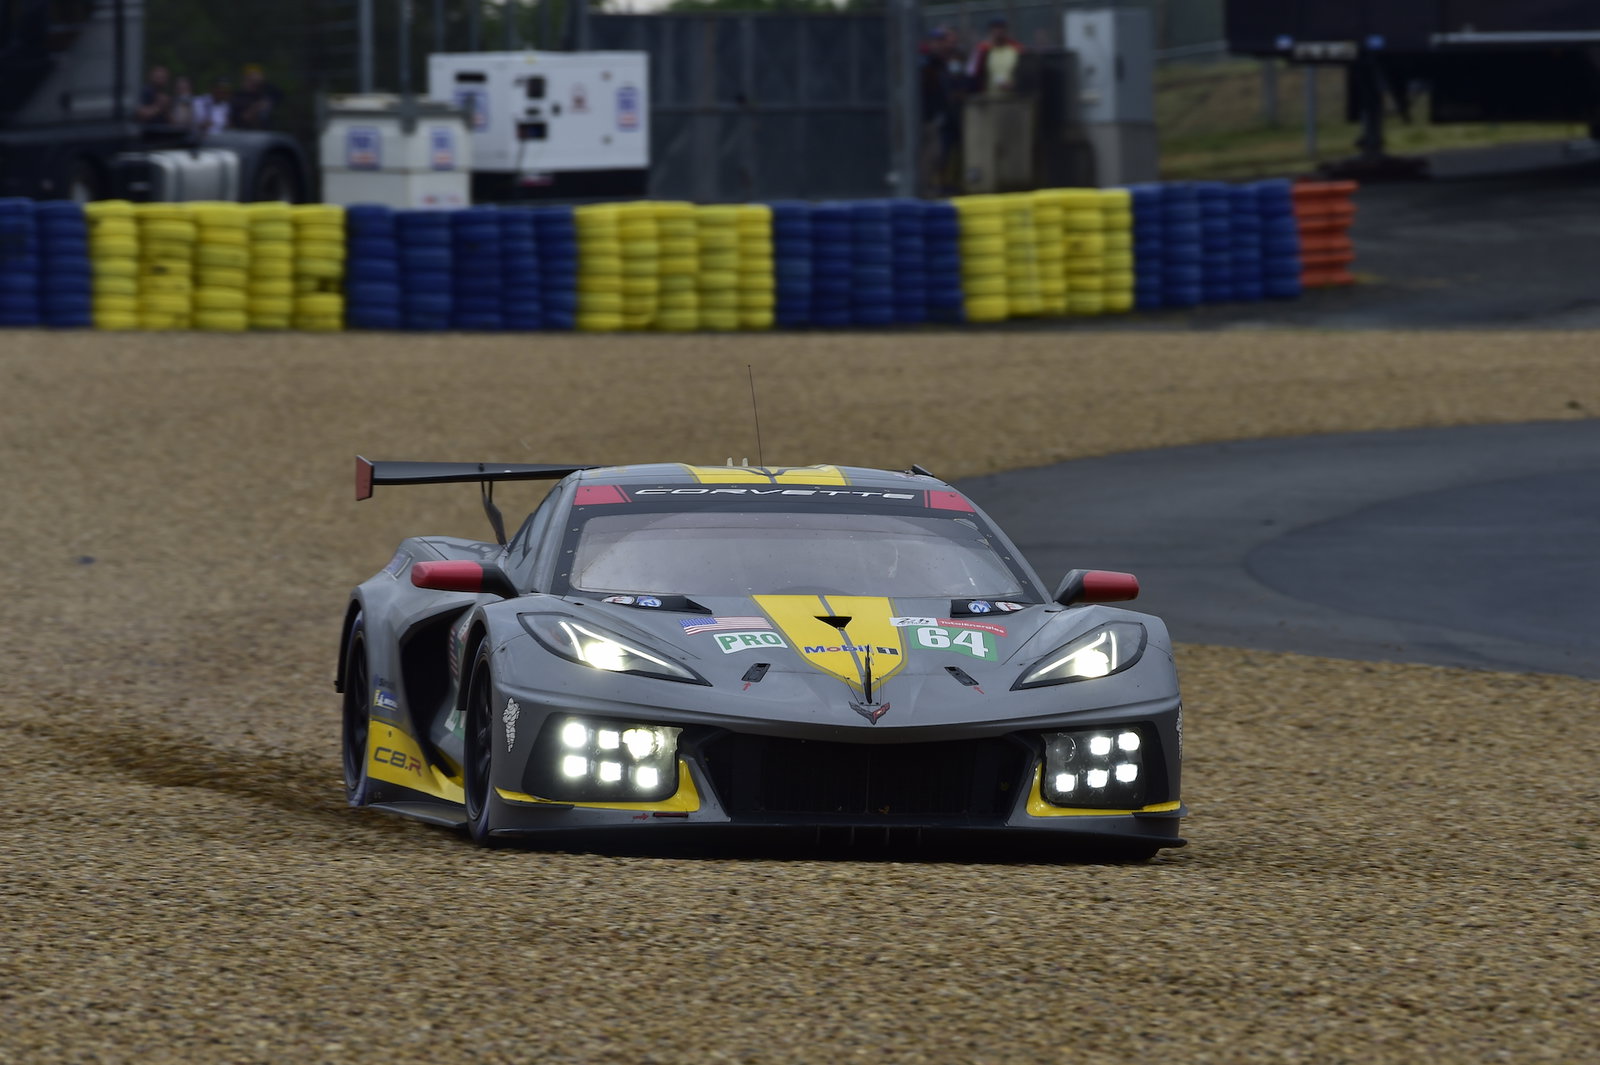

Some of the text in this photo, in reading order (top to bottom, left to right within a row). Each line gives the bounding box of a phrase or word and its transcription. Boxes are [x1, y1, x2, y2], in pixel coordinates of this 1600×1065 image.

[634, 488, 916, 500] CORVETTE
[717, 633, 782, 650] PRO
[916, 627, 989, 659] 64
[373, 746, 422, 777] C8.R
